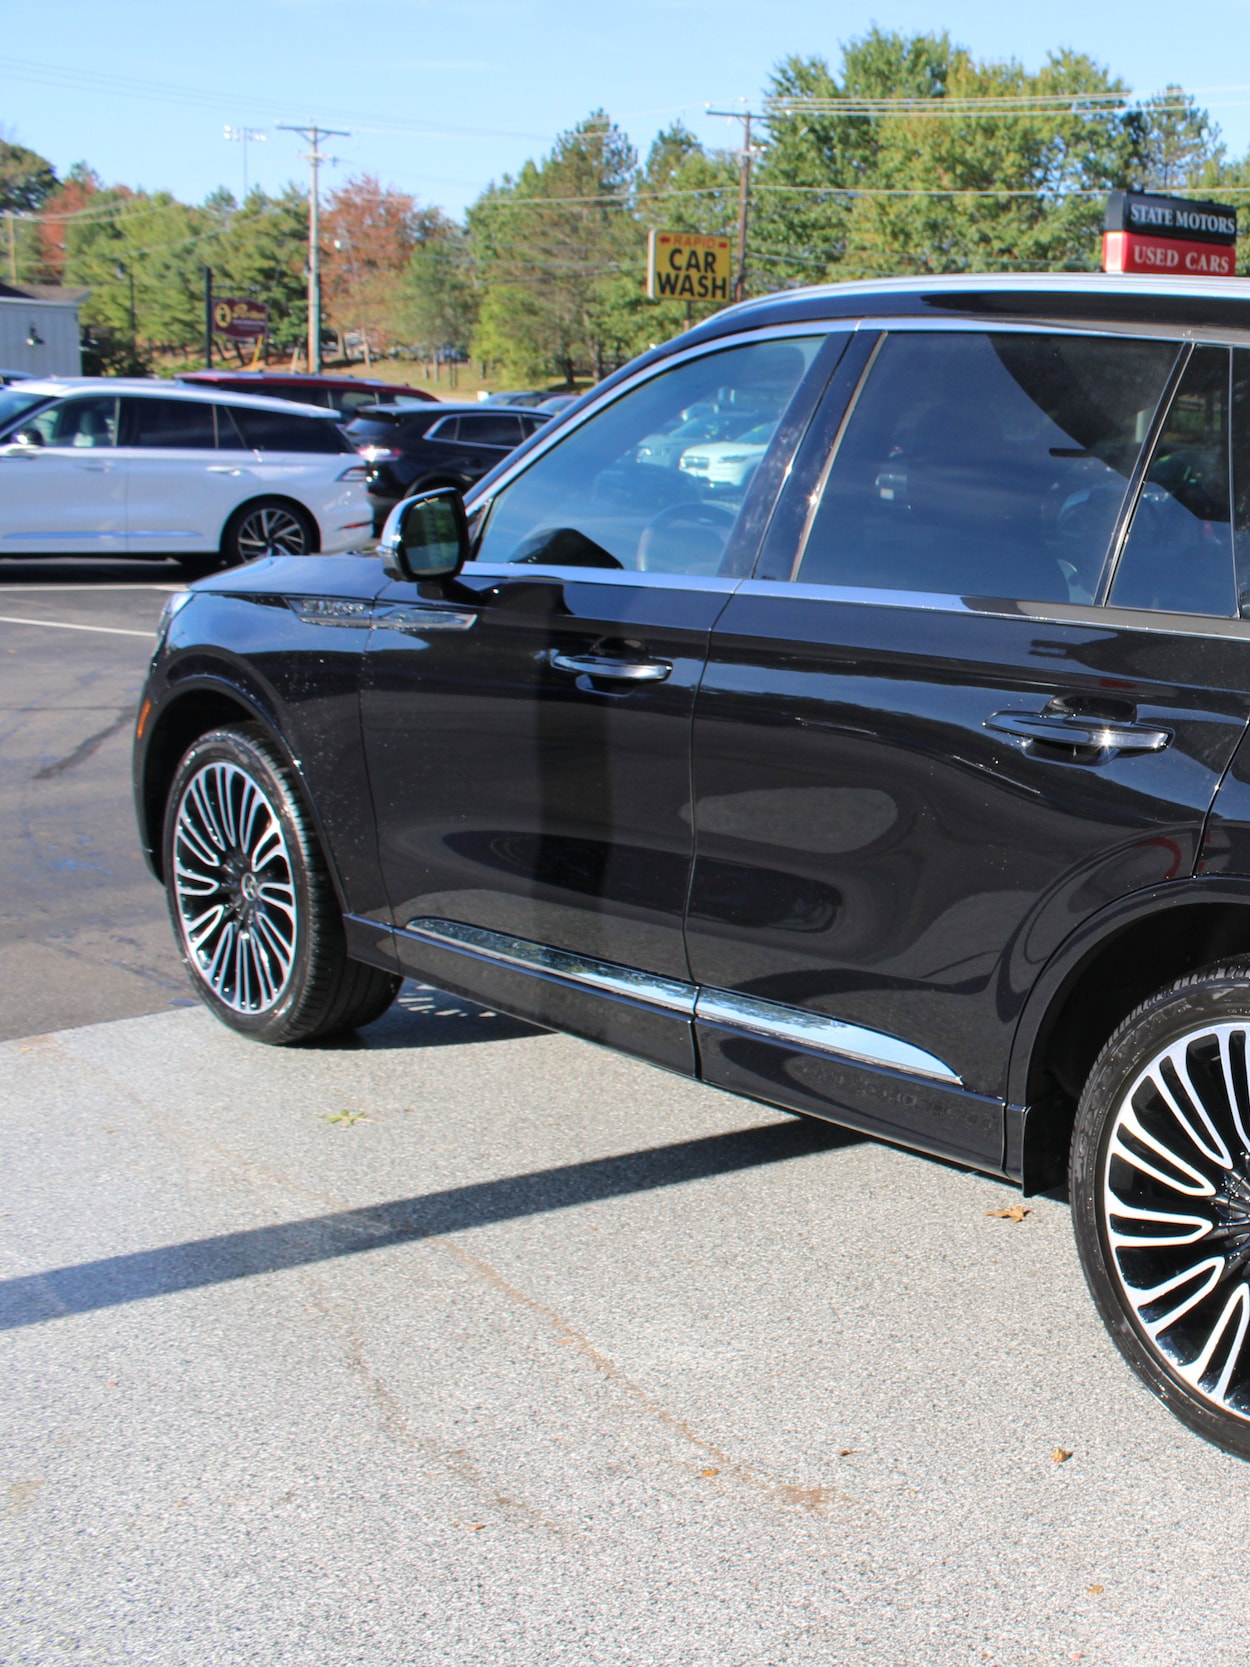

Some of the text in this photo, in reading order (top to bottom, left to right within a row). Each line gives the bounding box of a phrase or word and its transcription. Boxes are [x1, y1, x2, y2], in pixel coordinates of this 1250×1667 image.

[1130, 203, 1236, 235] STATE MOTORS
[674, 234, 716, 250] RAPID
[669, 248, 717, 274] CAR
[1134, 245, 1230, 273] USED CARS
[657, 272, 727, 299] WASH
